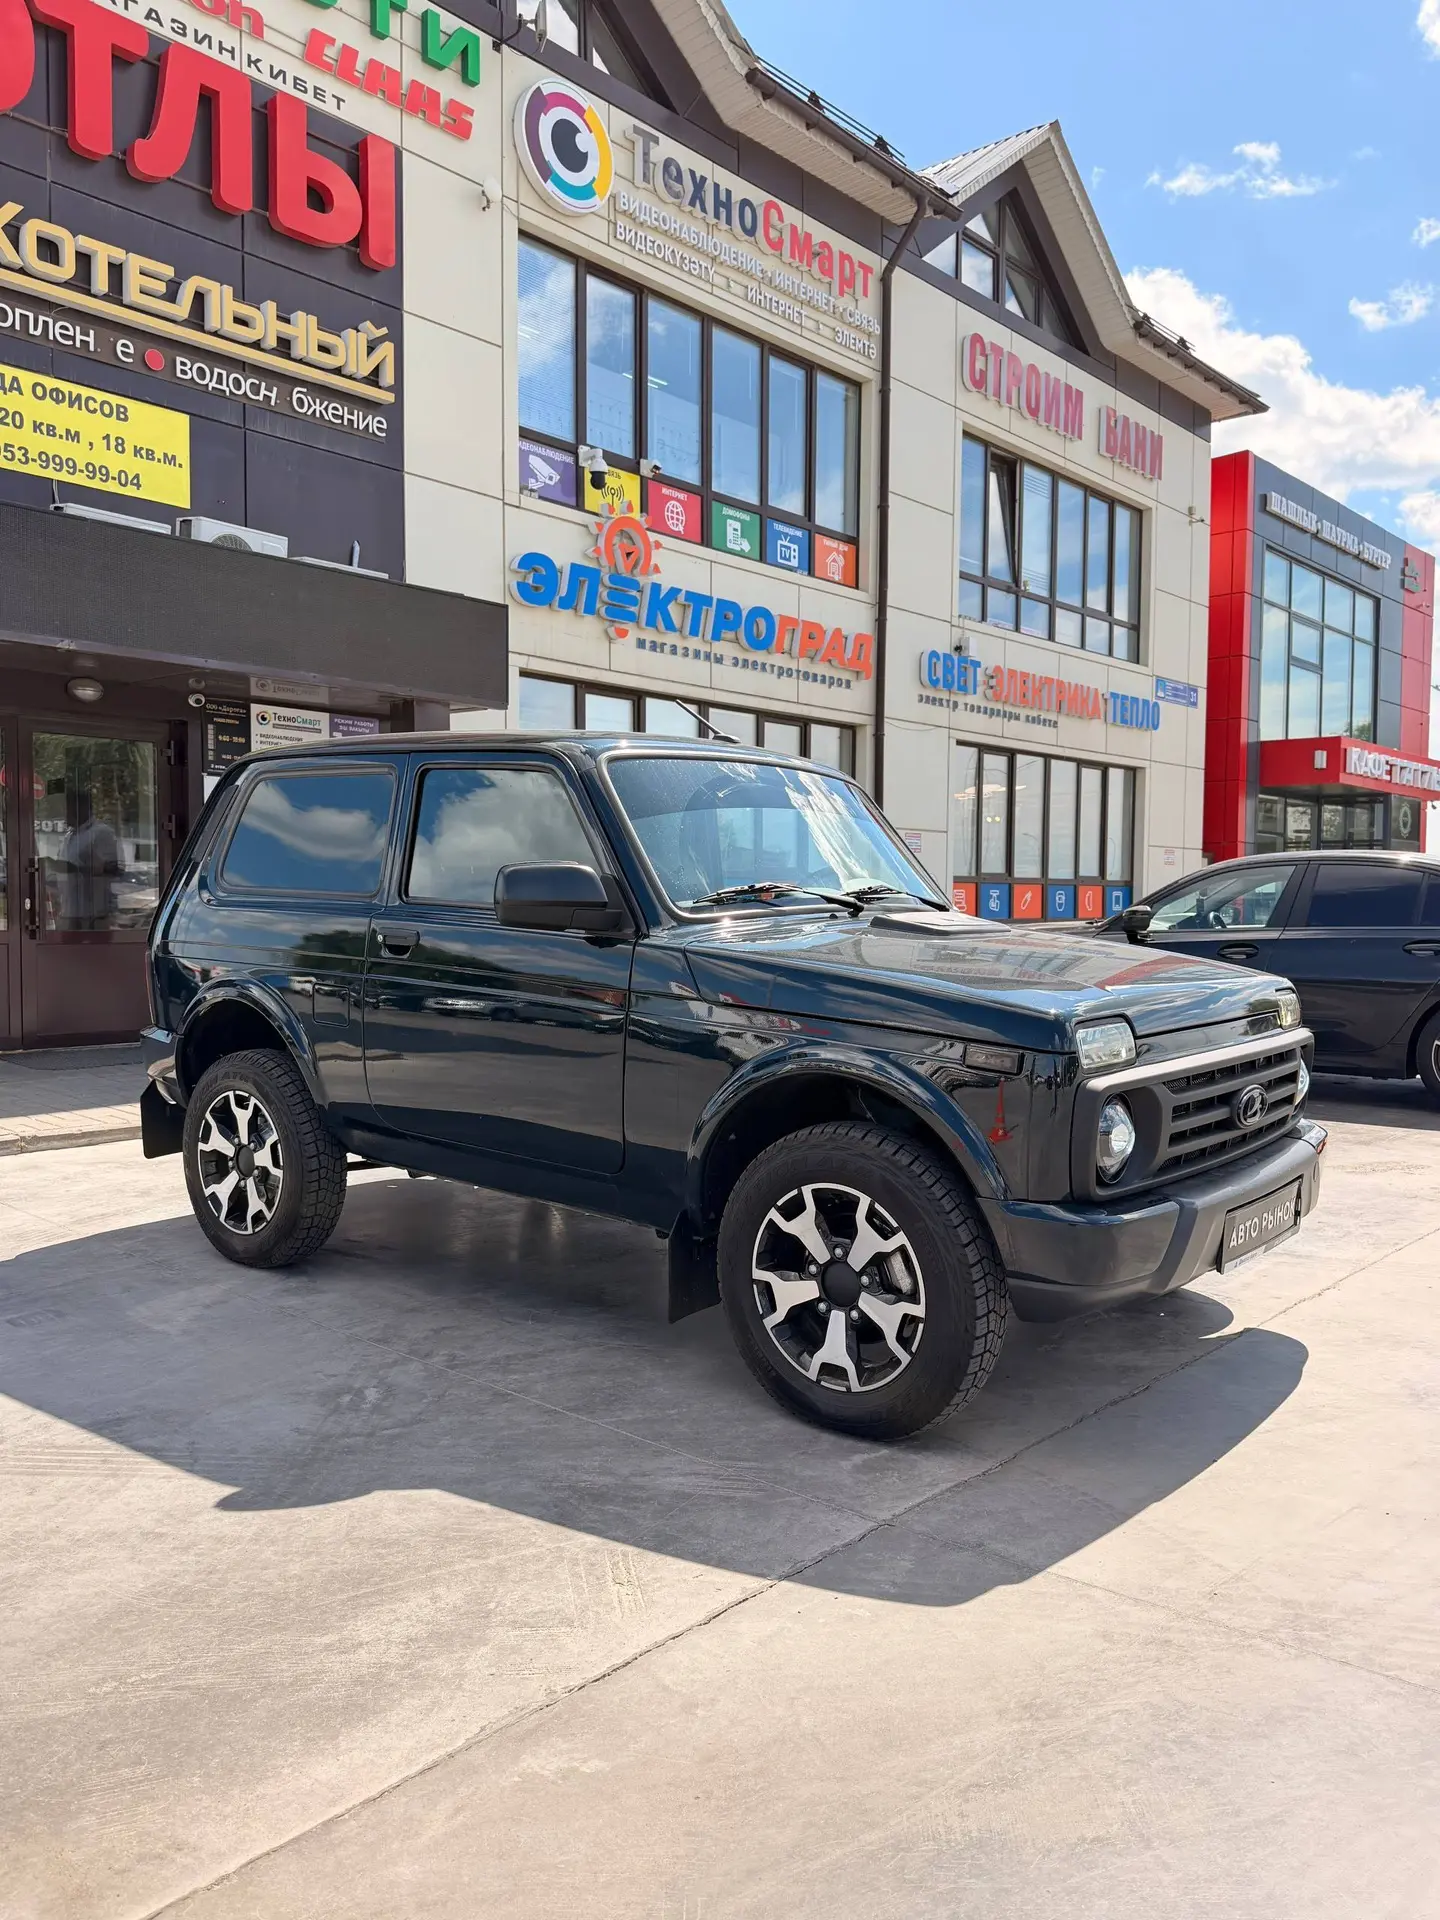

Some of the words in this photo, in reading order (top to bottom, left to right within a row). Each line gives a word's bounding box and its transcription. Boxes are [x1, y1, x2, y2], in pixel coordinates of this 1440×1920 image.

[109, 0, 235, 62] ГАЗИН
[247, 53, 346, 111] КИБЕТ
[303, 27, 475, 141] CLAAS
[626, 122, 874, 299] ТехноСмарт
[618, 190, 763, 279] ВИДЕОНАБЛЮДЕНИЕ
[775, 267, 836, 314] ИНТЕРНЕТ
[847, 305, 881, 335] СВЯЗЬ
[747, 284, 807, 328] ИНТЕРНЕТ
[31, 381, 129, 423] ОФИСОВ
[964, 332, 1084, 441] СТРОИМ
[1100, 405, 1163, 480] БАНИ
[0, 442, 142, 490] 53-999-99-04
[101, 433, 126, 455] 18
[1271, 491, 1318, 534] ШАШЛЫК
[1322, 519, 1359, 554] ШАУРМА
[1362, 541, 1392, 570] БУРГЕР
[512, 551, 873, 681] ЭЛЕКТРОГРАД
[635, 637, 725, 665] магазины
[731, 655, 853, 690] электротоваров
[922, 650, 982, 696] СВЕТ
[989, 664, 1102, 719] ЭЛЕКТРИКА
[1109, 690, 1161, 731] ТЕПЛО
[272, 712, 321, 727] ТехноСмарт
[1347, 746, 1391, 781] КАФЕ
[1229, 1216, 1259, 1249] АВТО
[1261, 1197, 1296, 1233] РЫНОК
